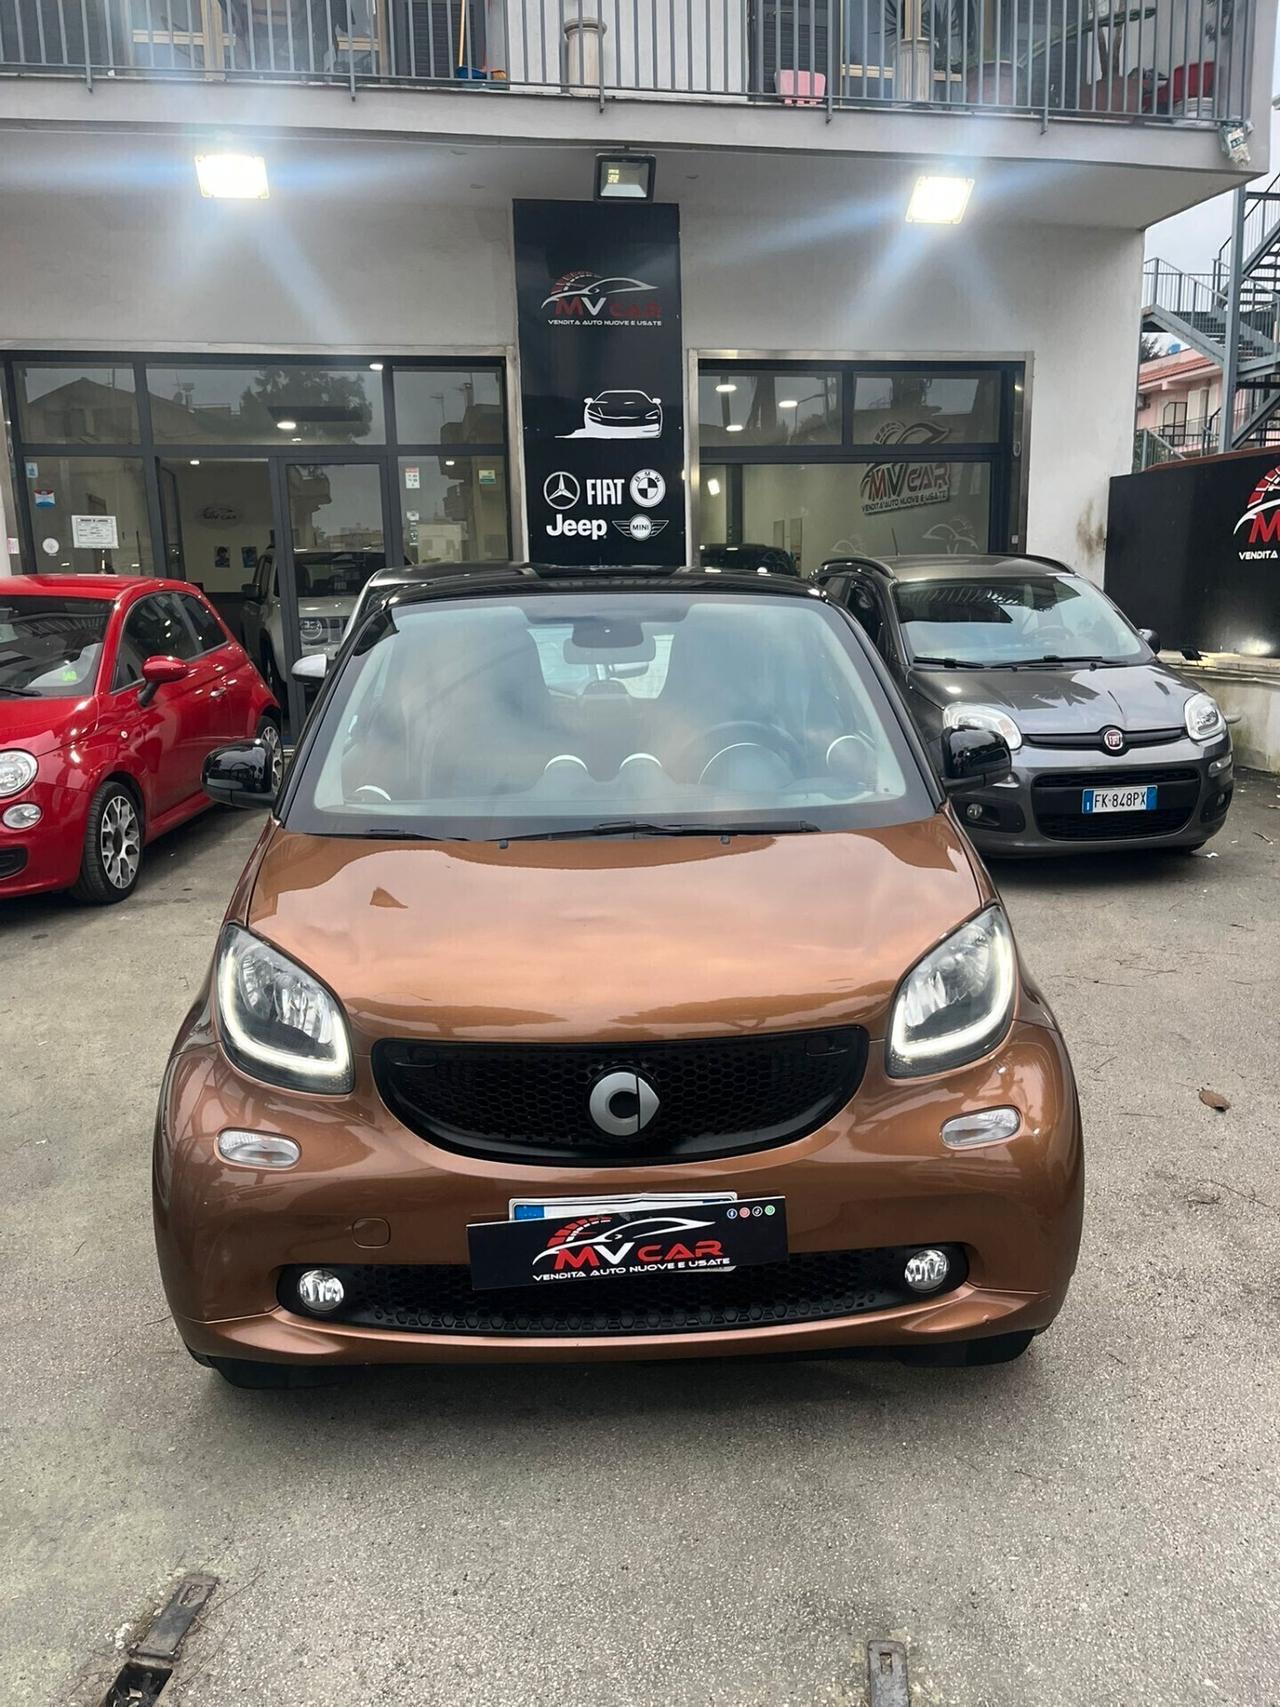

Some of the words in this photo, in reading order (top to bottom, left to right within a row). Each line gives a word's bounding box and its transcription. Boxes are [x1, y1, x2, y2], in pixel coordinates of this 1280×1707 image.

[555, 297, 607, 316] MV
[586, 479, 625, 505] FIAT
[546, 514, 607, 540] Jeep
[1238, 551, 1278, 560] VENDITA
[554, 1242, 635, 1270] MV
[638, 1240, 723, 1262] CAR
[532, 1271, 587, 1282] VENDITA
[589, 1267, 626, 1277] AUTO
[629, 1262, 675, 1274] NUOVE
[678, 1261, 685, 1269] E
[689, 1258, 731, 1267] USATE
